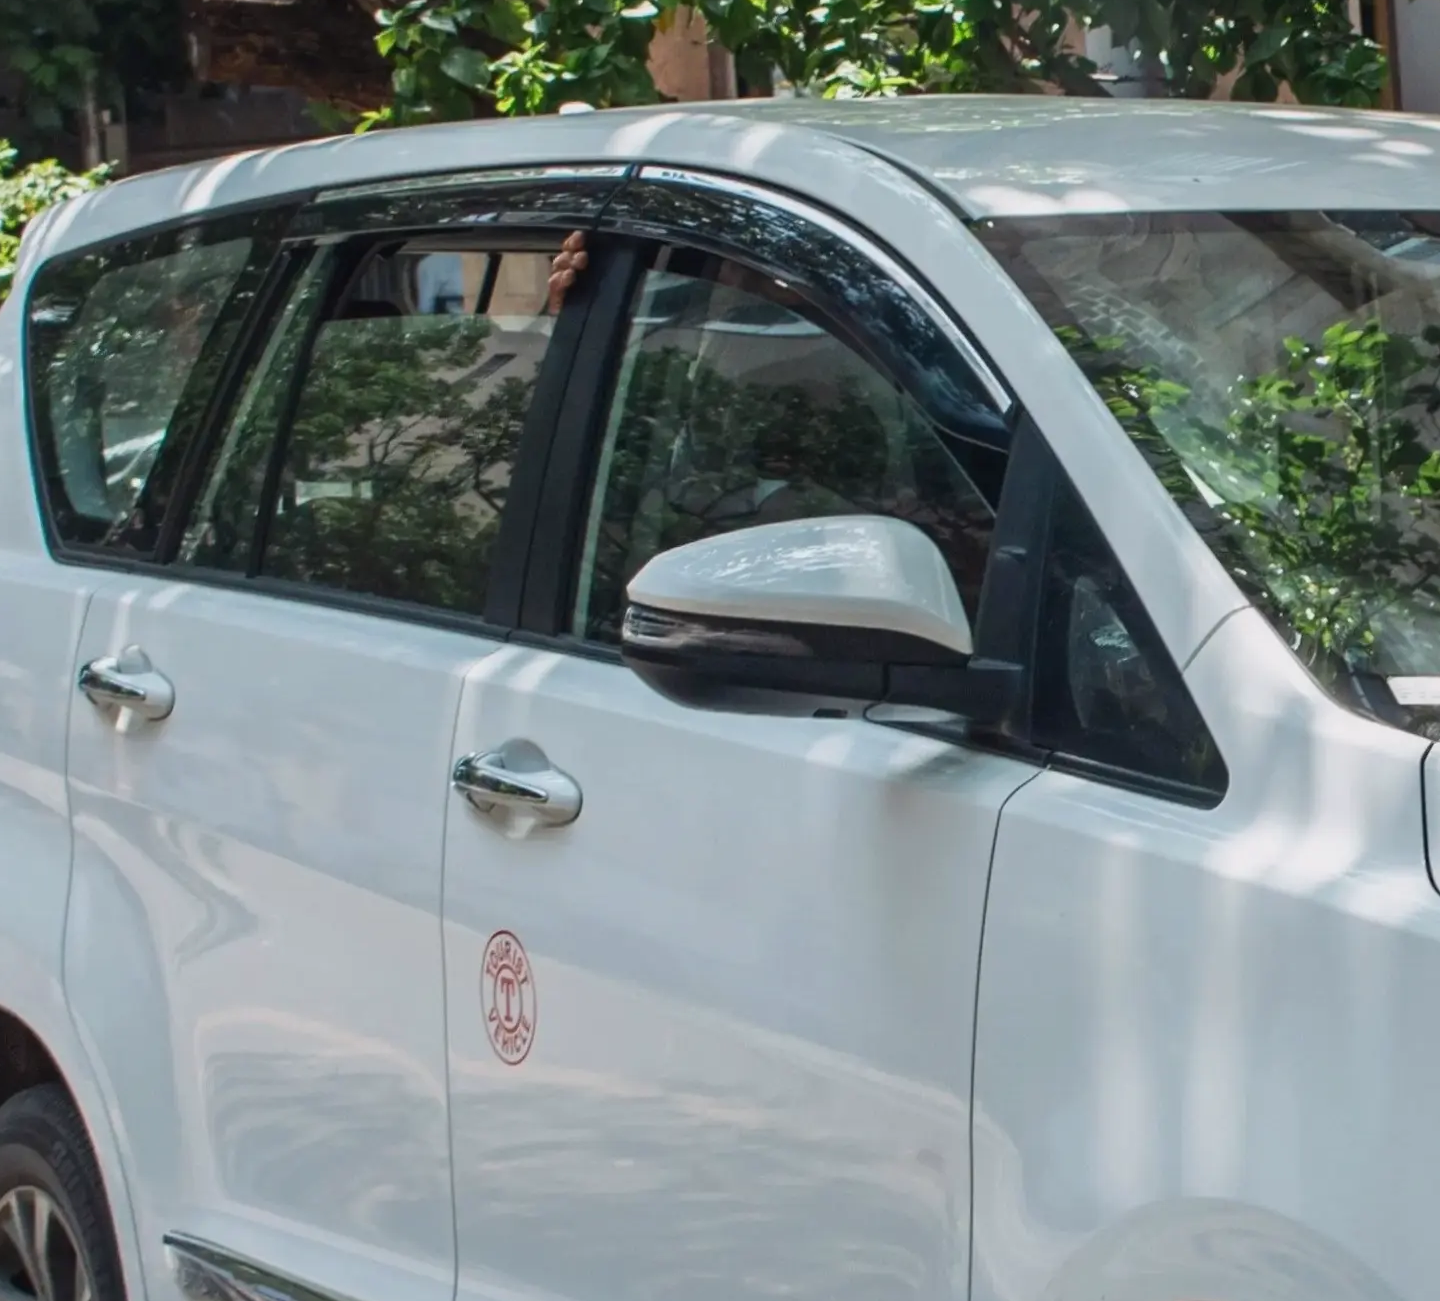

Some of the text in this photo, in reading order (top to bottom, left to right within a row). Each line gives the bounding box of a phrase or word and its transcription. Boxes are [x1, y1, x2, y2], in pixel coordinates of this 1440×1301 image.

[486, 939, 529, 984] TOURIST
[500, 977, 515, 1022] T
[488, 1007, 530, 1055] VEHICLE
